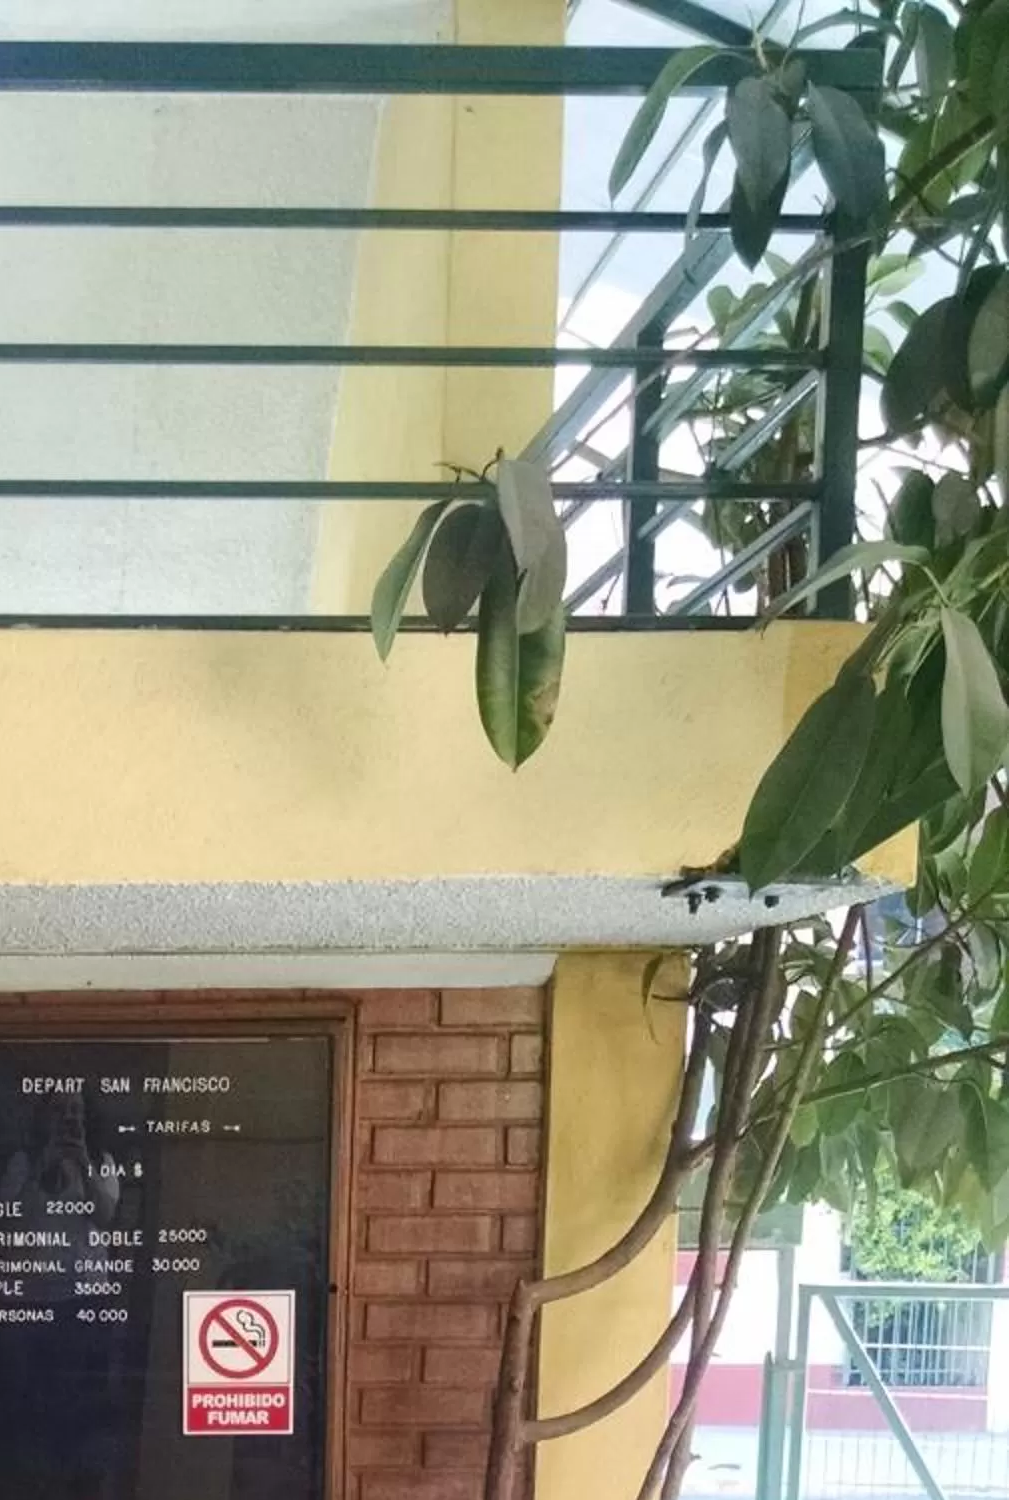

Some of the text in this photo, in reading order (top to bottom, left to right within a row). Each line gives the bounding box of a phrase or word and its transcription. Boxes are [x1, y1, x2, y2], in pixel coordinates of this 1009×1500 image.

[22, 1076, 230, 1094] DEPART SAN FRANCISCO
[146, 1119, 211, 1133] TARIFAS
[46, 1200, 95, 1215] 22000
[89, 1230, 143, 1247] DOBLE
[74, 1259, 134, 1273] GRANDE
[74, 1282, 122, 1296] 35000
[192, 1392, 285, 1409] PROHIBIDO
[207, 1410, 269, 1425] FUMAR
